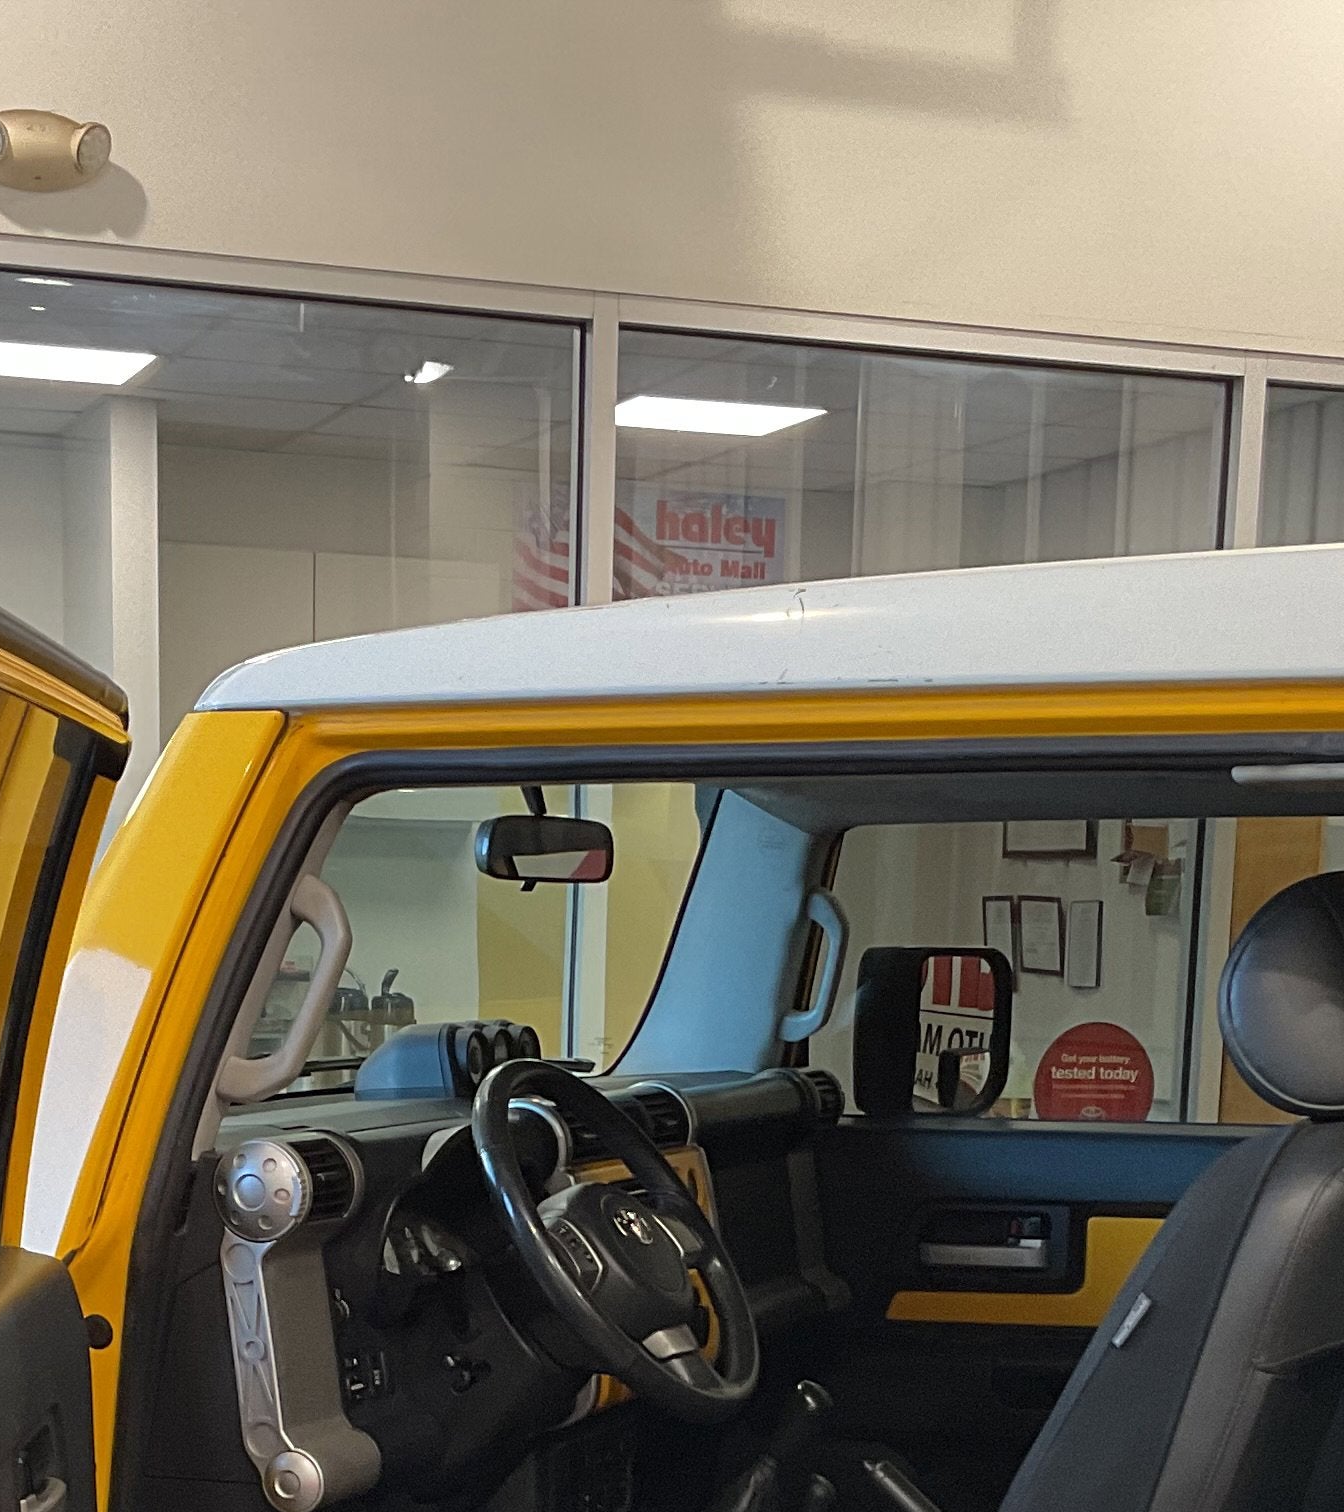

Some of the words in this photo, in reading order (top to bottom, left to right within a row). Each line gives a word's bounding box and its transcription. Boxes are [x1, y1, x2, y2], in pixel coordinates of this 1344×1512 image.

[656, 499, 776, 558] haley
[720, 559, 766, 580] Mall
[1051, 1066, 1096, 1080] tested
[1099, 1066, 1138, 1083] today
